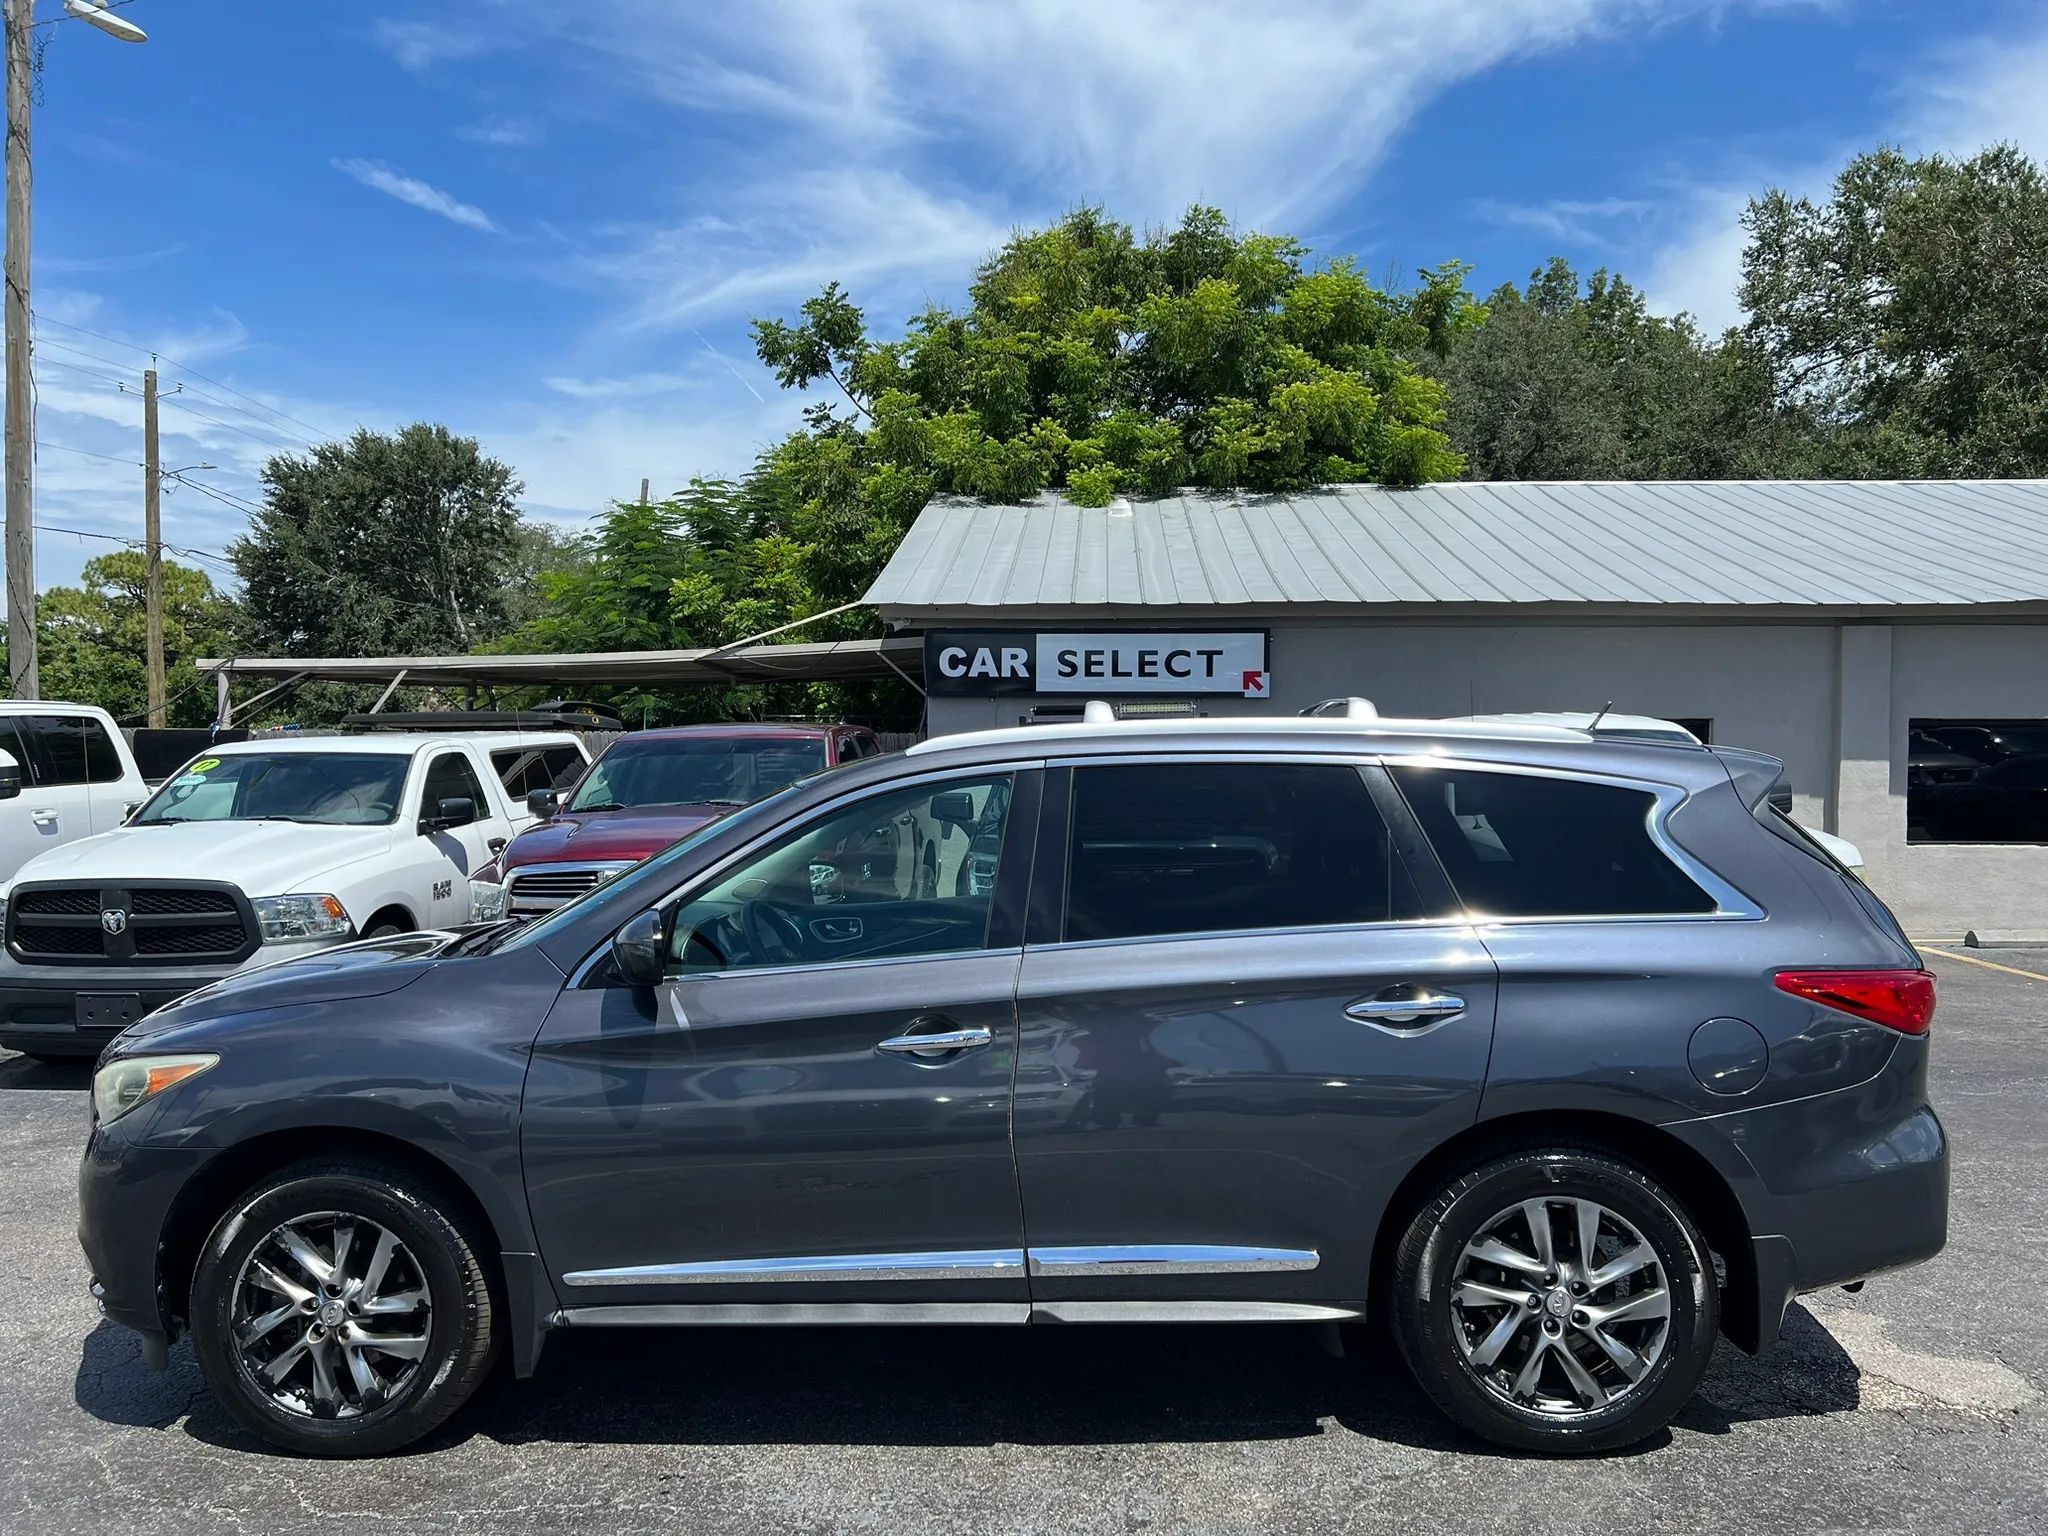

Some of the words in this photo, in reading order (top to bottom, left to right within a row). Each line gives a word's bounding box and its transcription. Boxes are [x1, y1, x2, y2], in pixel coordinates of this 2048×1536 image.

[939, 647, 1030, 678] CAR
[1057, 649, 1224, 678] SELECT
[433, 880, 452, 891] RAM
